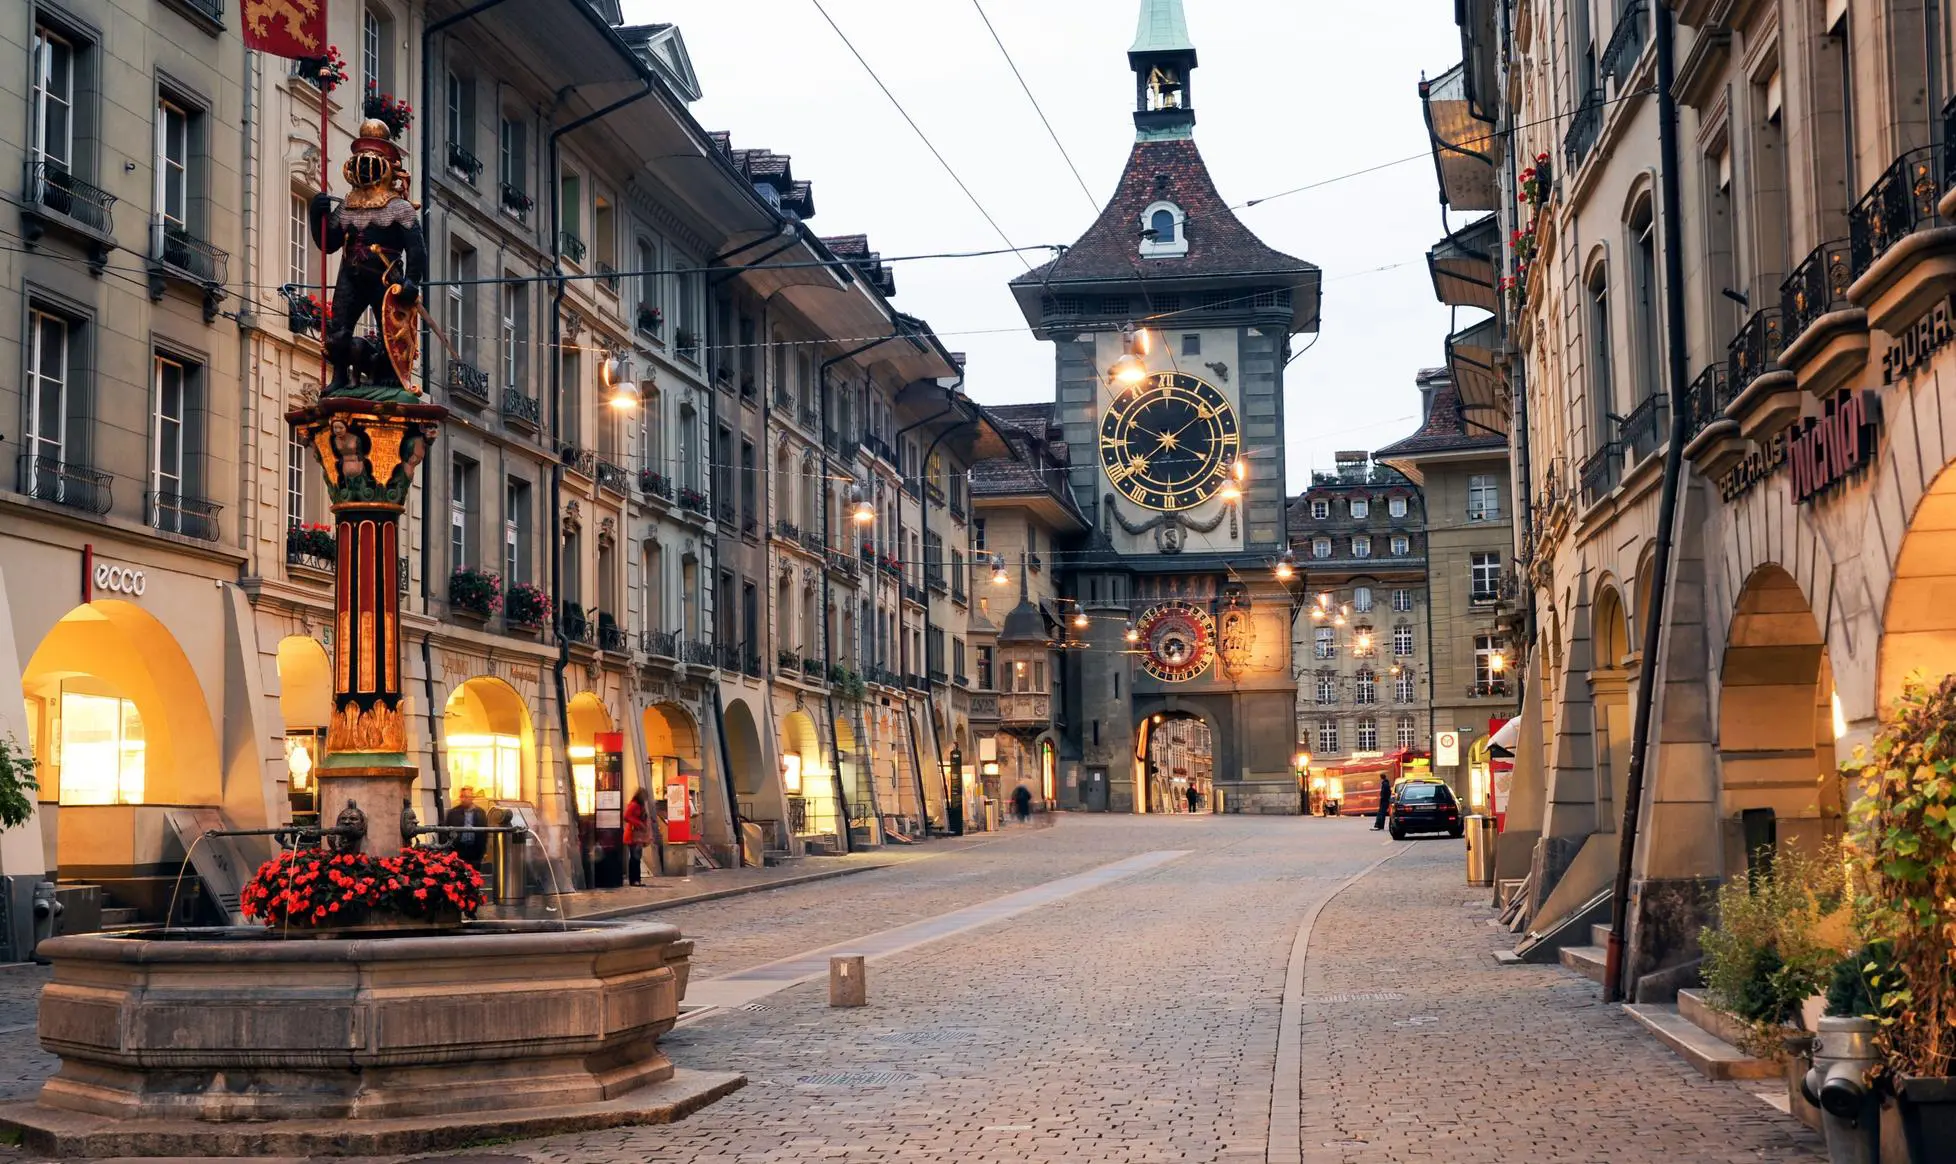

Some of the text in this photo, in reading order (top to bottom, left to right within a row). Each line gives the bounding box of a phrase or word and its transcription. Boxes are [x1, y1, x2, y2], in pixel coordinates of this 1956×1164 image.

[1158, 374, 1174, 387] XII
[1224, 433, 1237, 445] III
[1719, 432, 1784, 504] PELZHAUS
[95, 563, 146, 596] ecco
